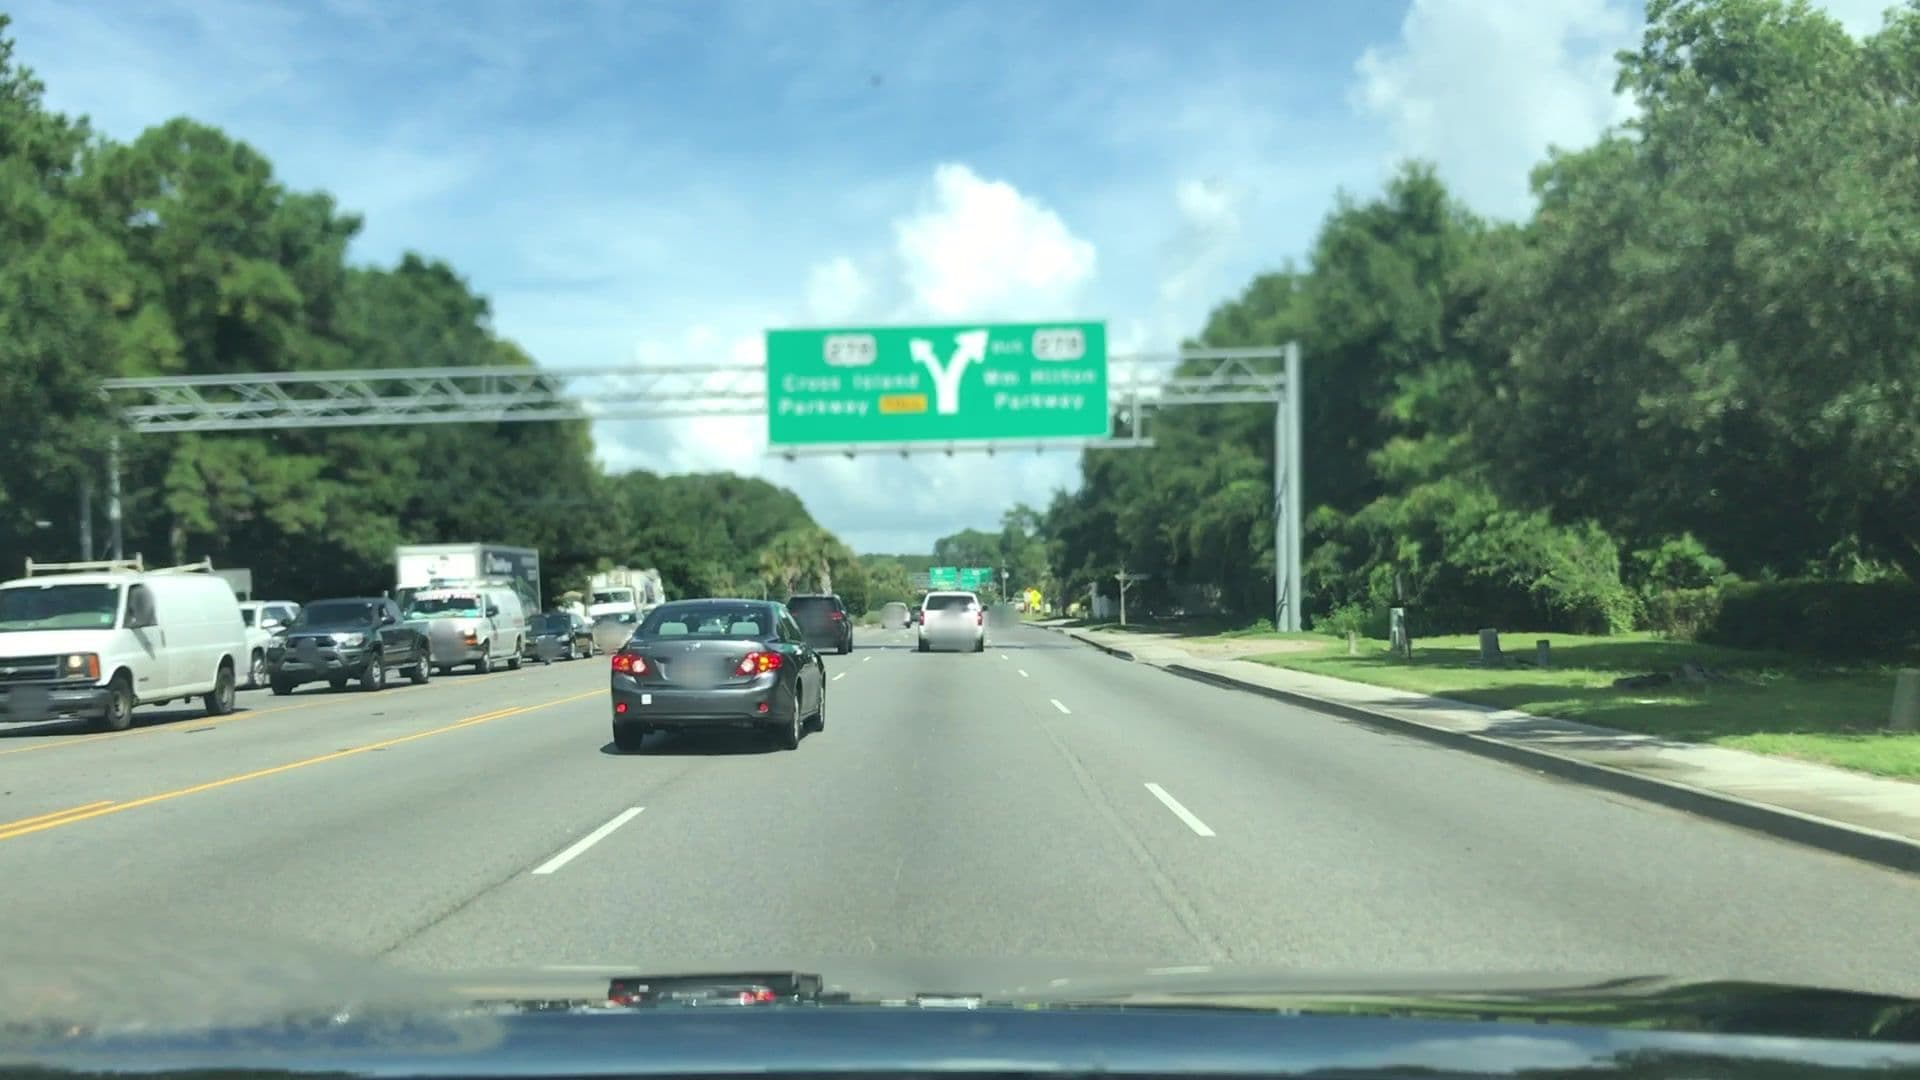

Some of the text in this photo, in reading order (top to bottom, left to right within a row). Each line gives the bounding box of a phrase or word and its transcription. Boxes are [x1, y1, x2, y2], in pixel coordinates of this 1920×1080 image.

[782, 371, 919, 392] Cross Island
[778, 397, 869, 418] Parkway
[994, 391, 1085, 411] Parkway
